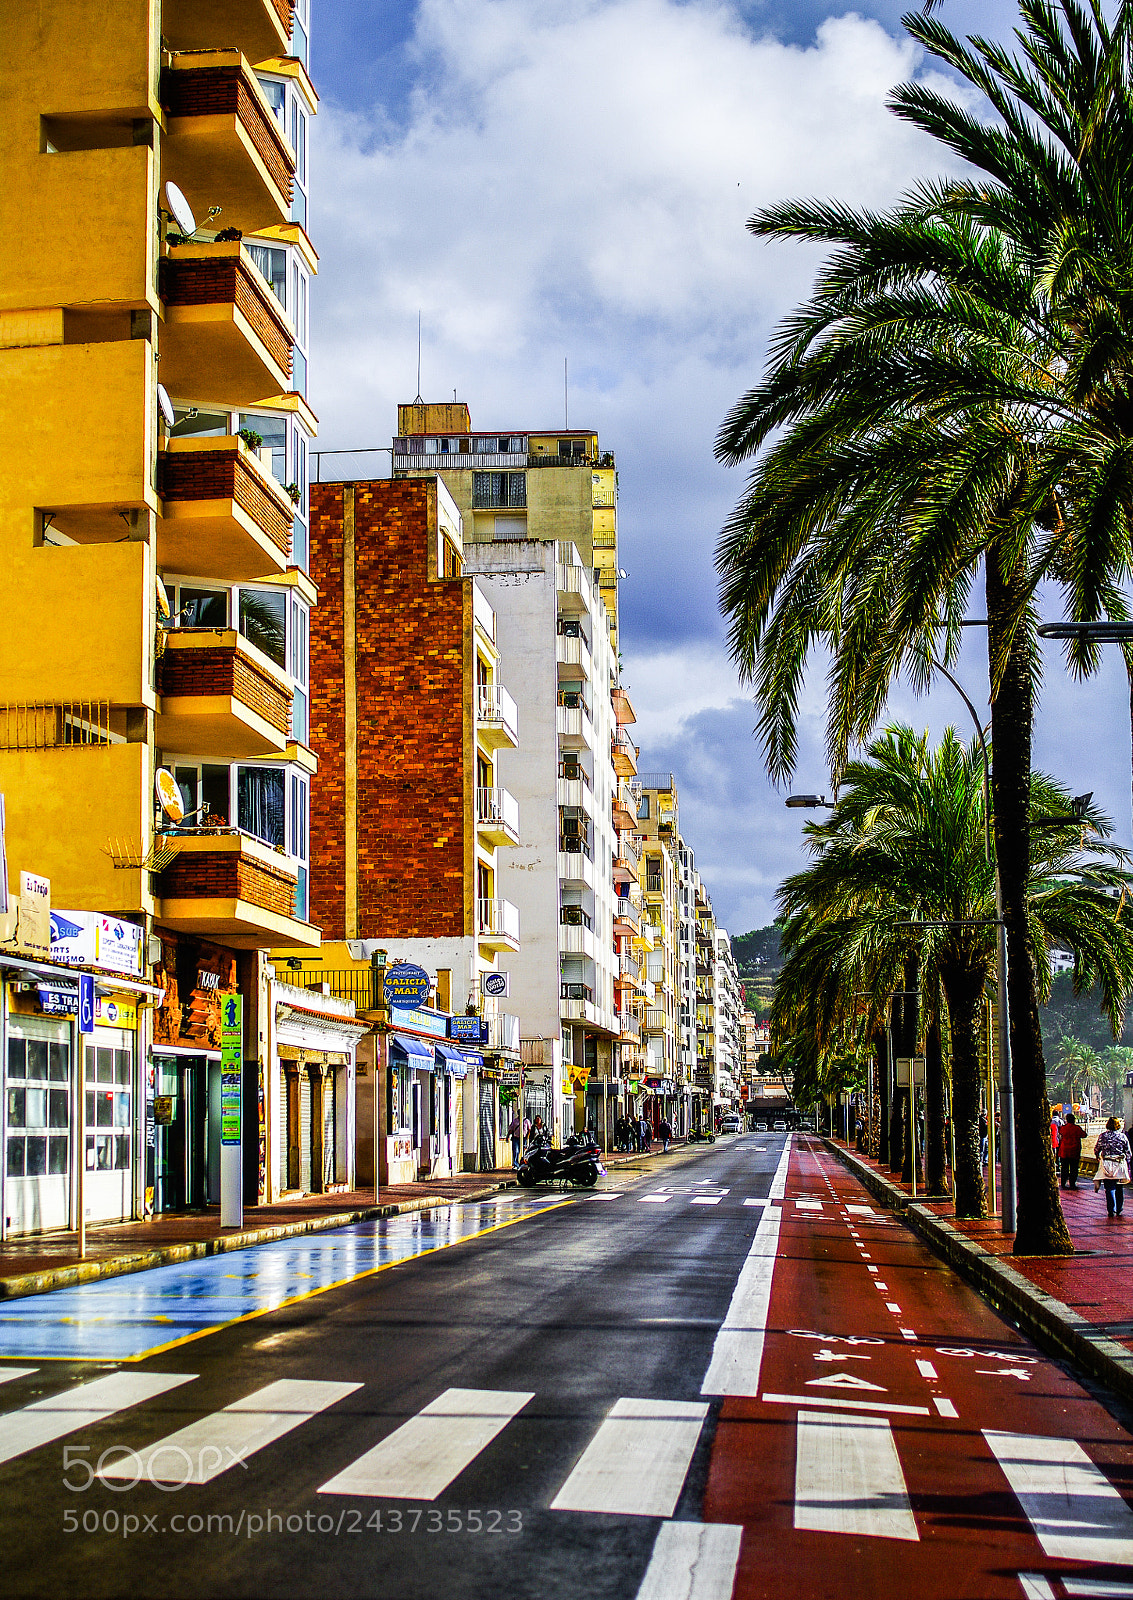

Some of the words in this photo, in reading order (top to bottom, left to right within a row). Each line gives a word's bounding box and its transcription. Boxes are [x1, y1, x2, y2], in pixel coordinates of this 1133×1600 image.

[59, 927, 79, 937] SUB
[385, 978, 427, 986] GALICIA
[394, 987, 419, 995] MAR
[48, 993, 60, 1004] ES
[62, 995, 79, 1007] TRA
